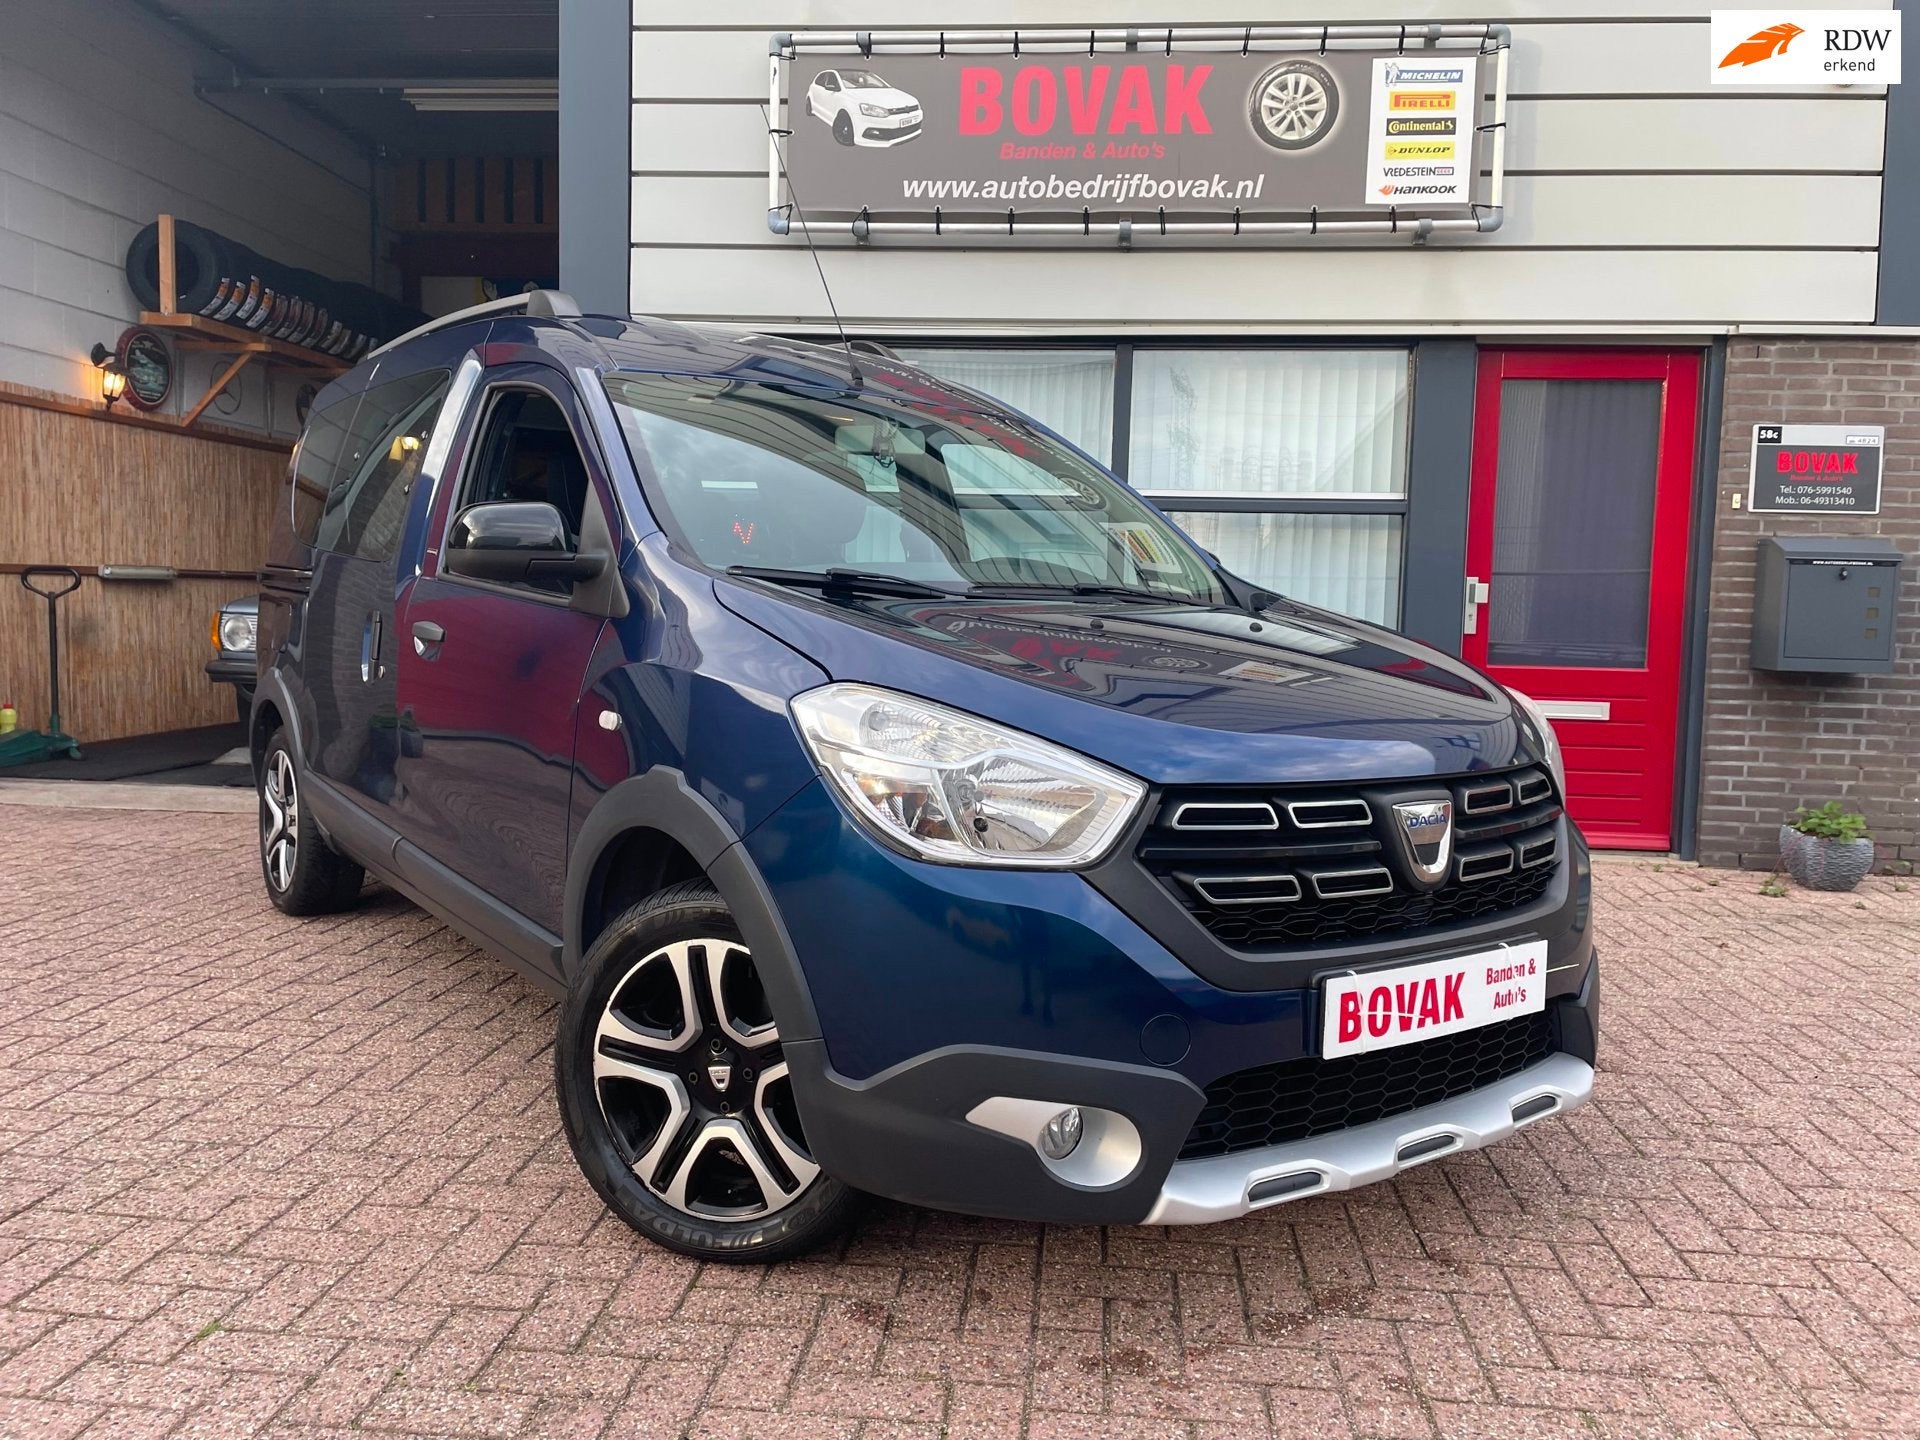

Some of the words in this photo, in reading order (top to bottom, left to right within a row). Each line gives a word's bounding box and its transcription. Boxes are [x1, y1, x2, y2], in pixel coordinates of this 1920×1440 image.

[1400, 71, 1461, 79] MICHELIN
[958, 64, 1214, 136] BOVAK
[1394, 94, 1451, 108] PIRELLI
[1388, 120, 1445, 133] Continental
[999, 142, 1076, 160] Banden
[1082, 142, 1096, 159] &
[1102, 142, 1165, 160] Auto's
[1383, 167, 1436, 176] VREDESTEIN
[902, 174, 1264, 203] www.autobedrijfbovak.nl
[1760, 429, 1779, 439] 58c
[1777, 452, 1858, 473] BOVAK
[1780, 485, 1796, 494] Tel.:
[1797, 485, 1852, 495] 076-5991540
[1775, 496, 1799, 505] Mob.:
[1800, 497, 1855, 506] 06-49313410
[1410, 814, 1447, 828] DACIA
[1528, 958, 1537, 976] &
[1339, 971, 1465, 1044] BOVAK
